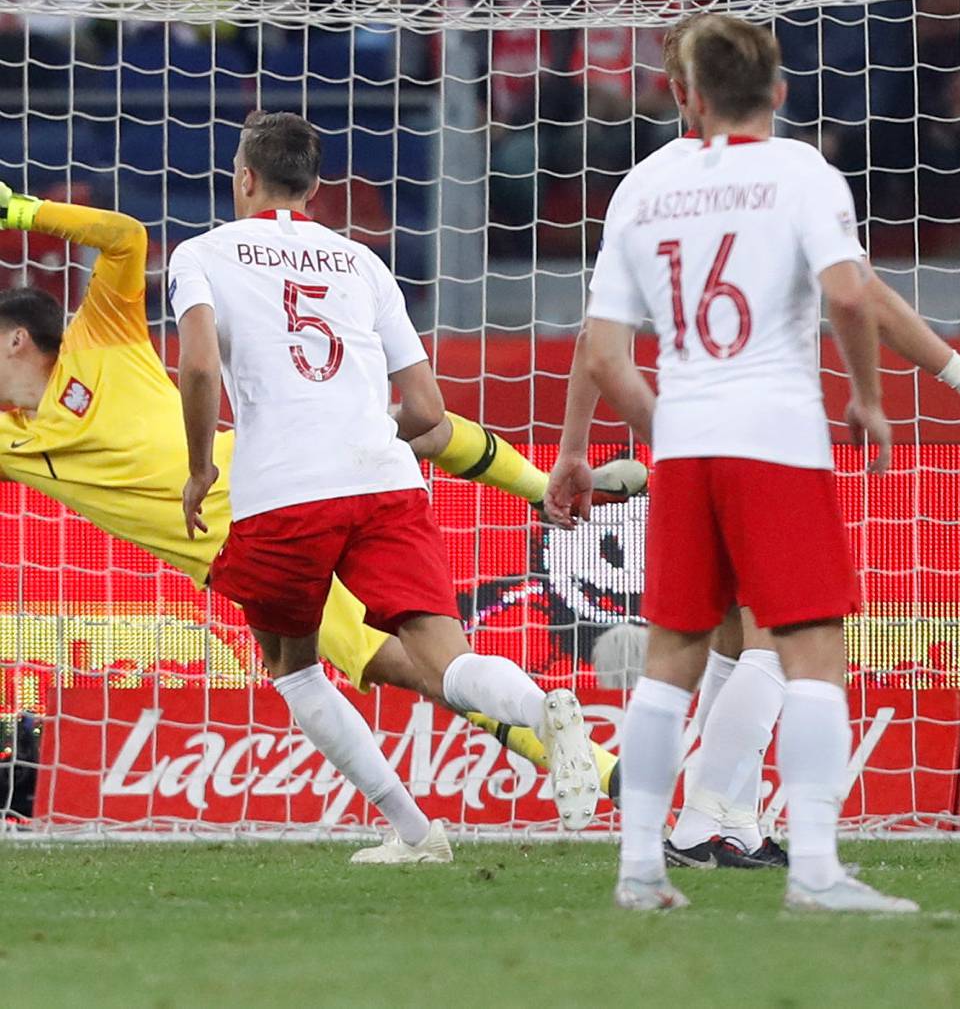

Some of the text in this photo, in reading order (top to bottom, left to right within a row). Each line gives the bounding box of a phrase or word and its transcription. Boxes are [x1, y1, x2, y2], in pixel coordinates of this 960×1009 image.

[237, 244, 361, 277] BEDNAREK
[656, 233, 752, 359] 16
[283, 279, 345, 383] 5
